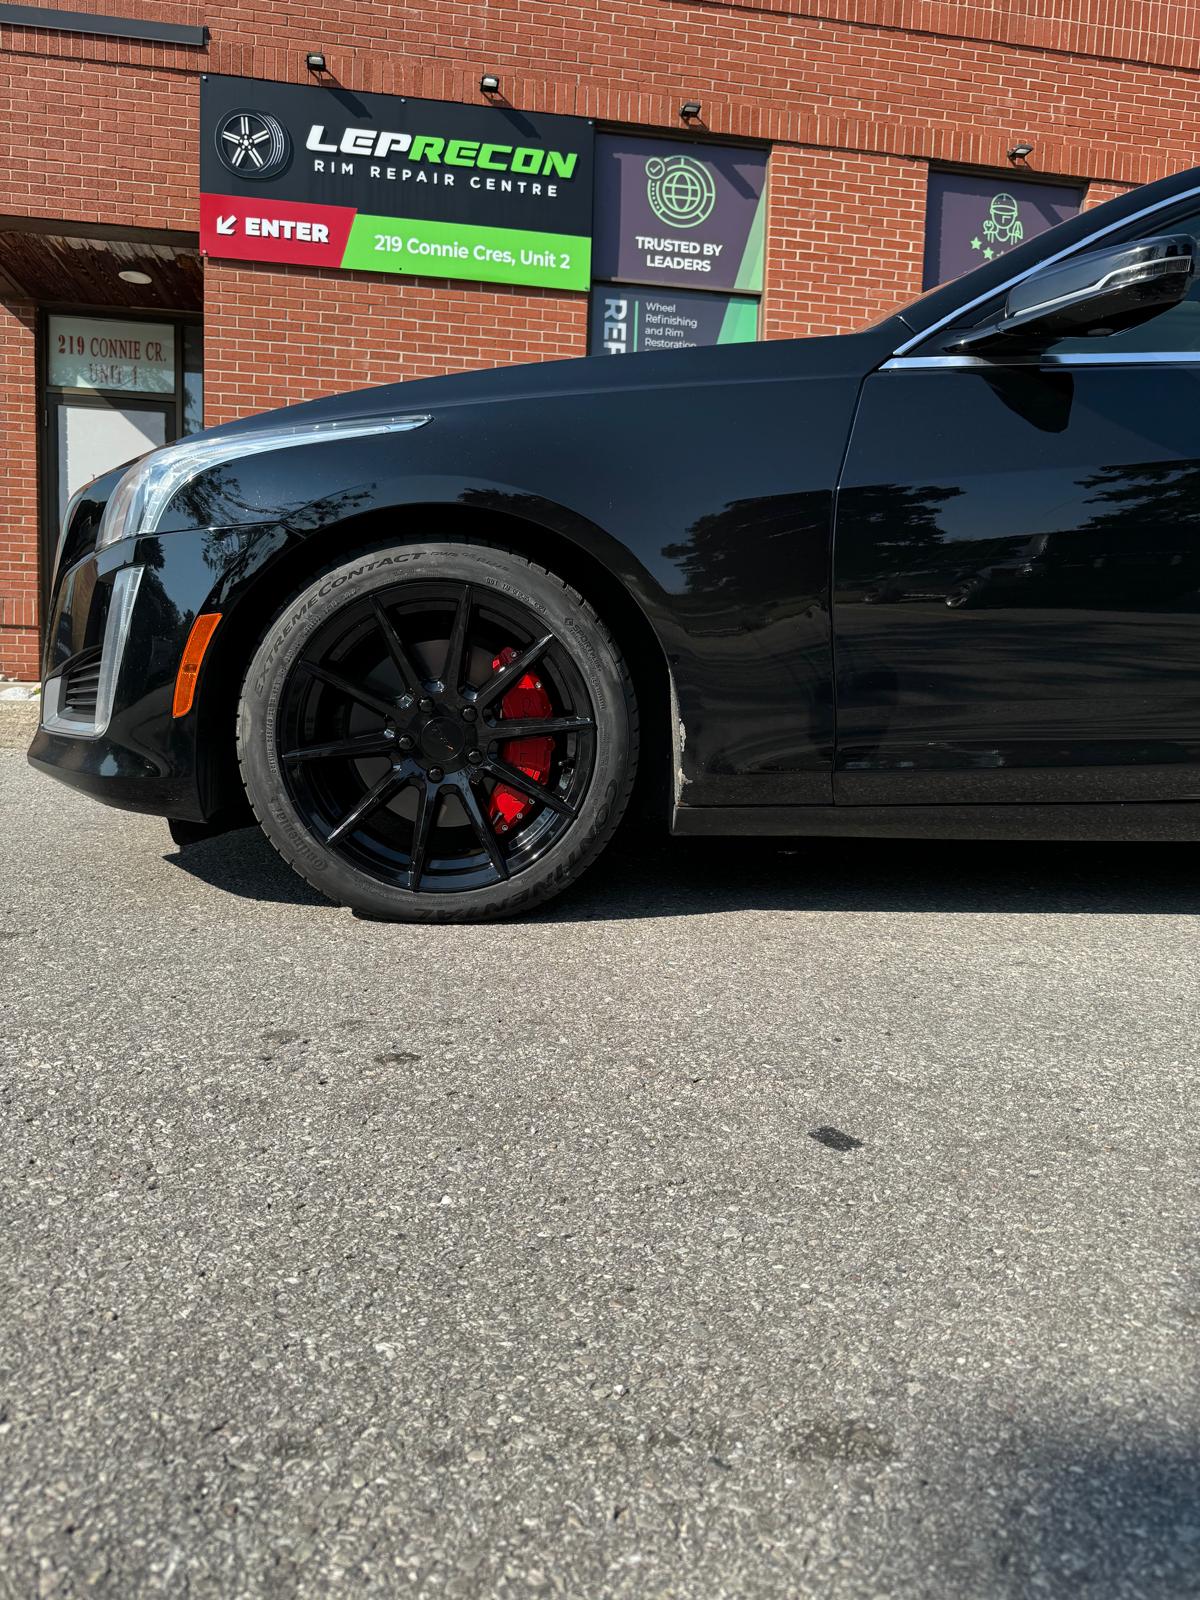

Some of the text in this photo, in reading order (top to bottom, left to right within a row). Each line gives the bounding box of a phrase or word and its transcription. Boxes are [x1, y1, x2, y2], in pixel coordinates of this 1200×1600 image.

[306, 124, 578, 179] LEPRECON
[314, 159, 558, 198] RIM REPAIR CENTRE
[245, 217, 329, 243] ENTER
[374, 233, 571, 269] 219 Connie Cres, Unit 2
[635, 236, 723, 257] TRUSTED BY
[646, 255, 711, 272] LEADERS
[645, 302, 676, 313] Wheel
[645, 313, 698, 329] Refinishing
[645, 327, 684, 337] and Rim
[58, 334, 167, 362] 219 CONNIE CR.
[89, 363, 124, 384] UNIT
